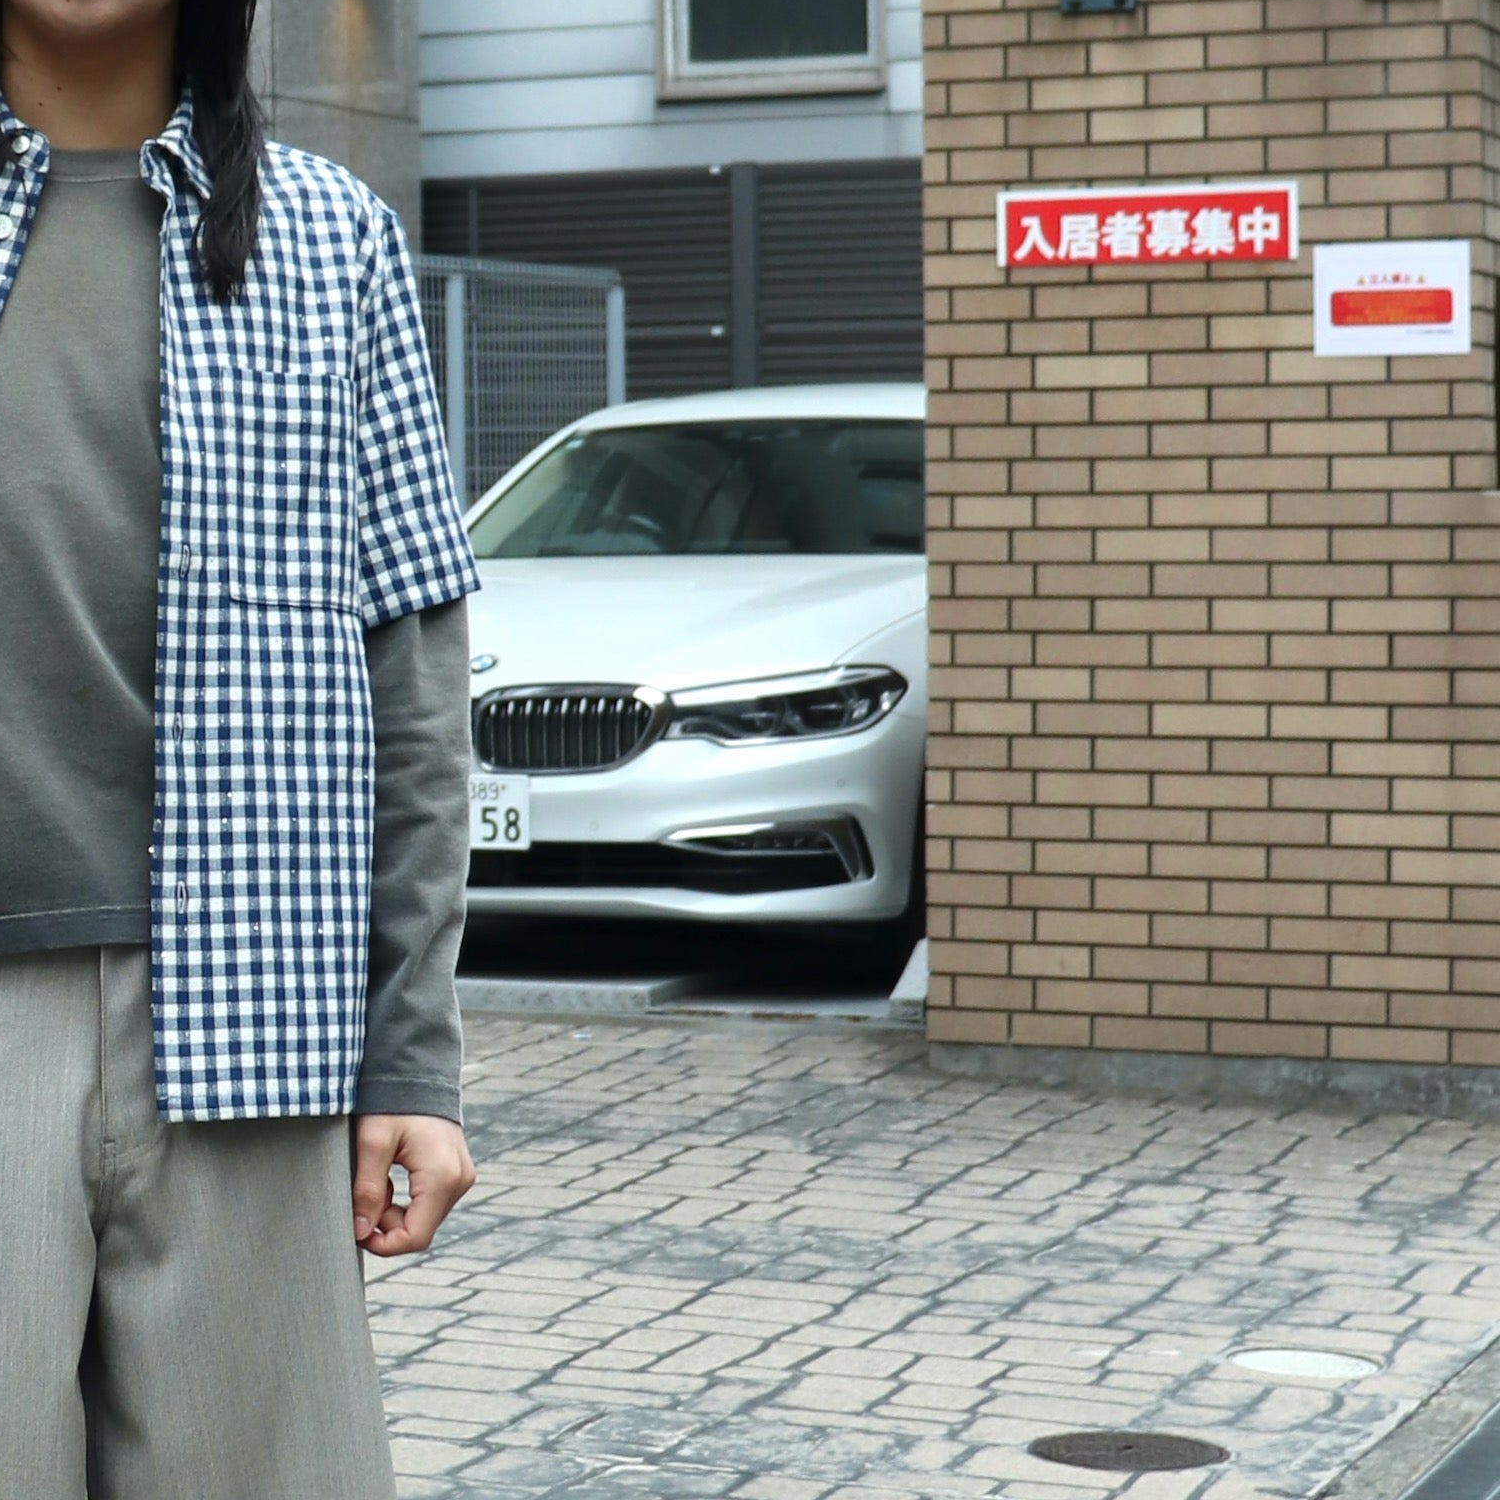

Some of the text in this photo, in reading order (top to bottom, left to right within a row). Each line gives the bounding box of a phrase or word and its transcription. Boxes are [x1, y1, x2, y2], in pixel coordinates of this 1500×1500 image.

[1013, 205, 1281, 261] 入居者募集中
[481, 805, 521, 842] 58
